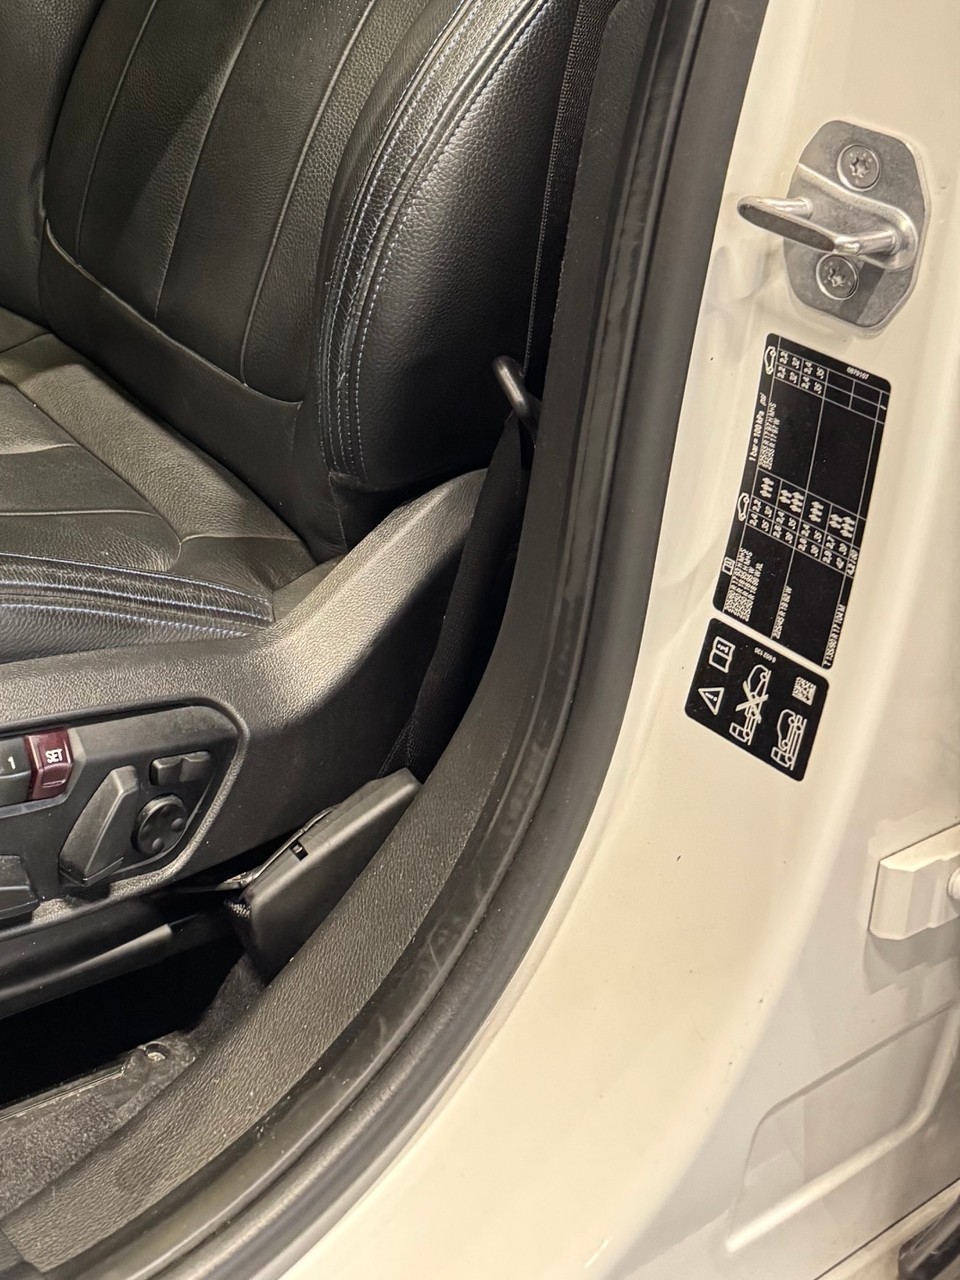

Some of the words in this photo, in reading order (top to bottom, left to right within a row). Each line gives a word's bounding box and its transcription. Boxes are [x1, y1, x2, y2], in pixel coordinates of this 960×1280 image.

[779, 351, 788, 364] 2,2
[792, 357, 800, 369] 32
[777, 366, 786, 379] 2,2
[804, 361, 813, 374] 2,4
[816, 367, 825, 379] 35
[789, 372, 797, 383] 32
[801, 376, 810, 389] 2,4
[814, 382, 822, 394] 35
[767, 402, 776, 417] M+S
[755, 410, 765, 424] kPa
[753, 424, 762, 437] 100
[749, 444, 758, 457] bar
[752, 499, 761, 512] 2,2
[764, 506, 773, 518] 32
[749, 513, 758, 526] 2,4
[776, 511, 785, 524] 2,4
[788, 517, 796, 530] 35
[761, 519, 769, 532] 35
[801, 524, 810, 537] 2,4
[826, 535, 835, 549] 2,7
[778, 609, 786, 617] R
[784, 584, 792, 594] W
[832, 623, 840, 633] 17
[837, 602, 845, 612] M
[45, 749, 63, 763] SET
[7, 756, 16, 770] 1
